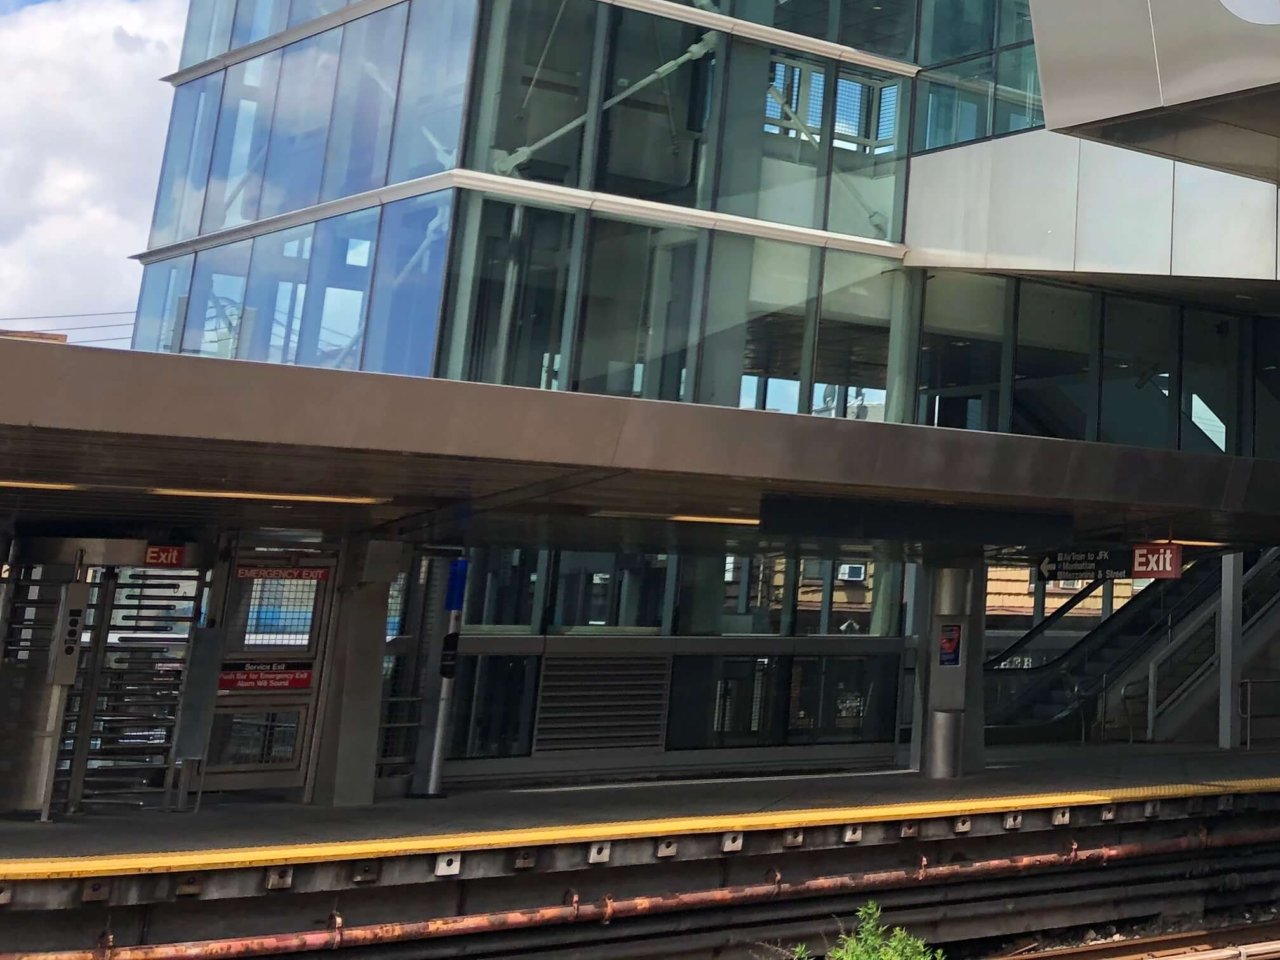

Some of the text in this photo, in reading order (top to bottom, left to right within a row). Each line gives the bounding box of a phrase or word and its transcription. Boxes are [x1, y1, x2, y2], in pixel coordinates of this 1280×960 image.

[145, 548, 179, 564] Exit
[1087, 552, 1095, 561] to
[1096, 550, 1110, 560] JFK
[1134, 549, 1172, 571] Exit
[1062, 561, 1096, 571] Manhattan
[238, 568, 325, 579] EMERGENCY EXIT
[1105, 569, 1126, 579] Street
[244, 663, 286, 671] Service Exit
[235, 672, 248, 680] Bar
[249, 672, 259, 680] for
[259, 672, 294, 681] Emergency
